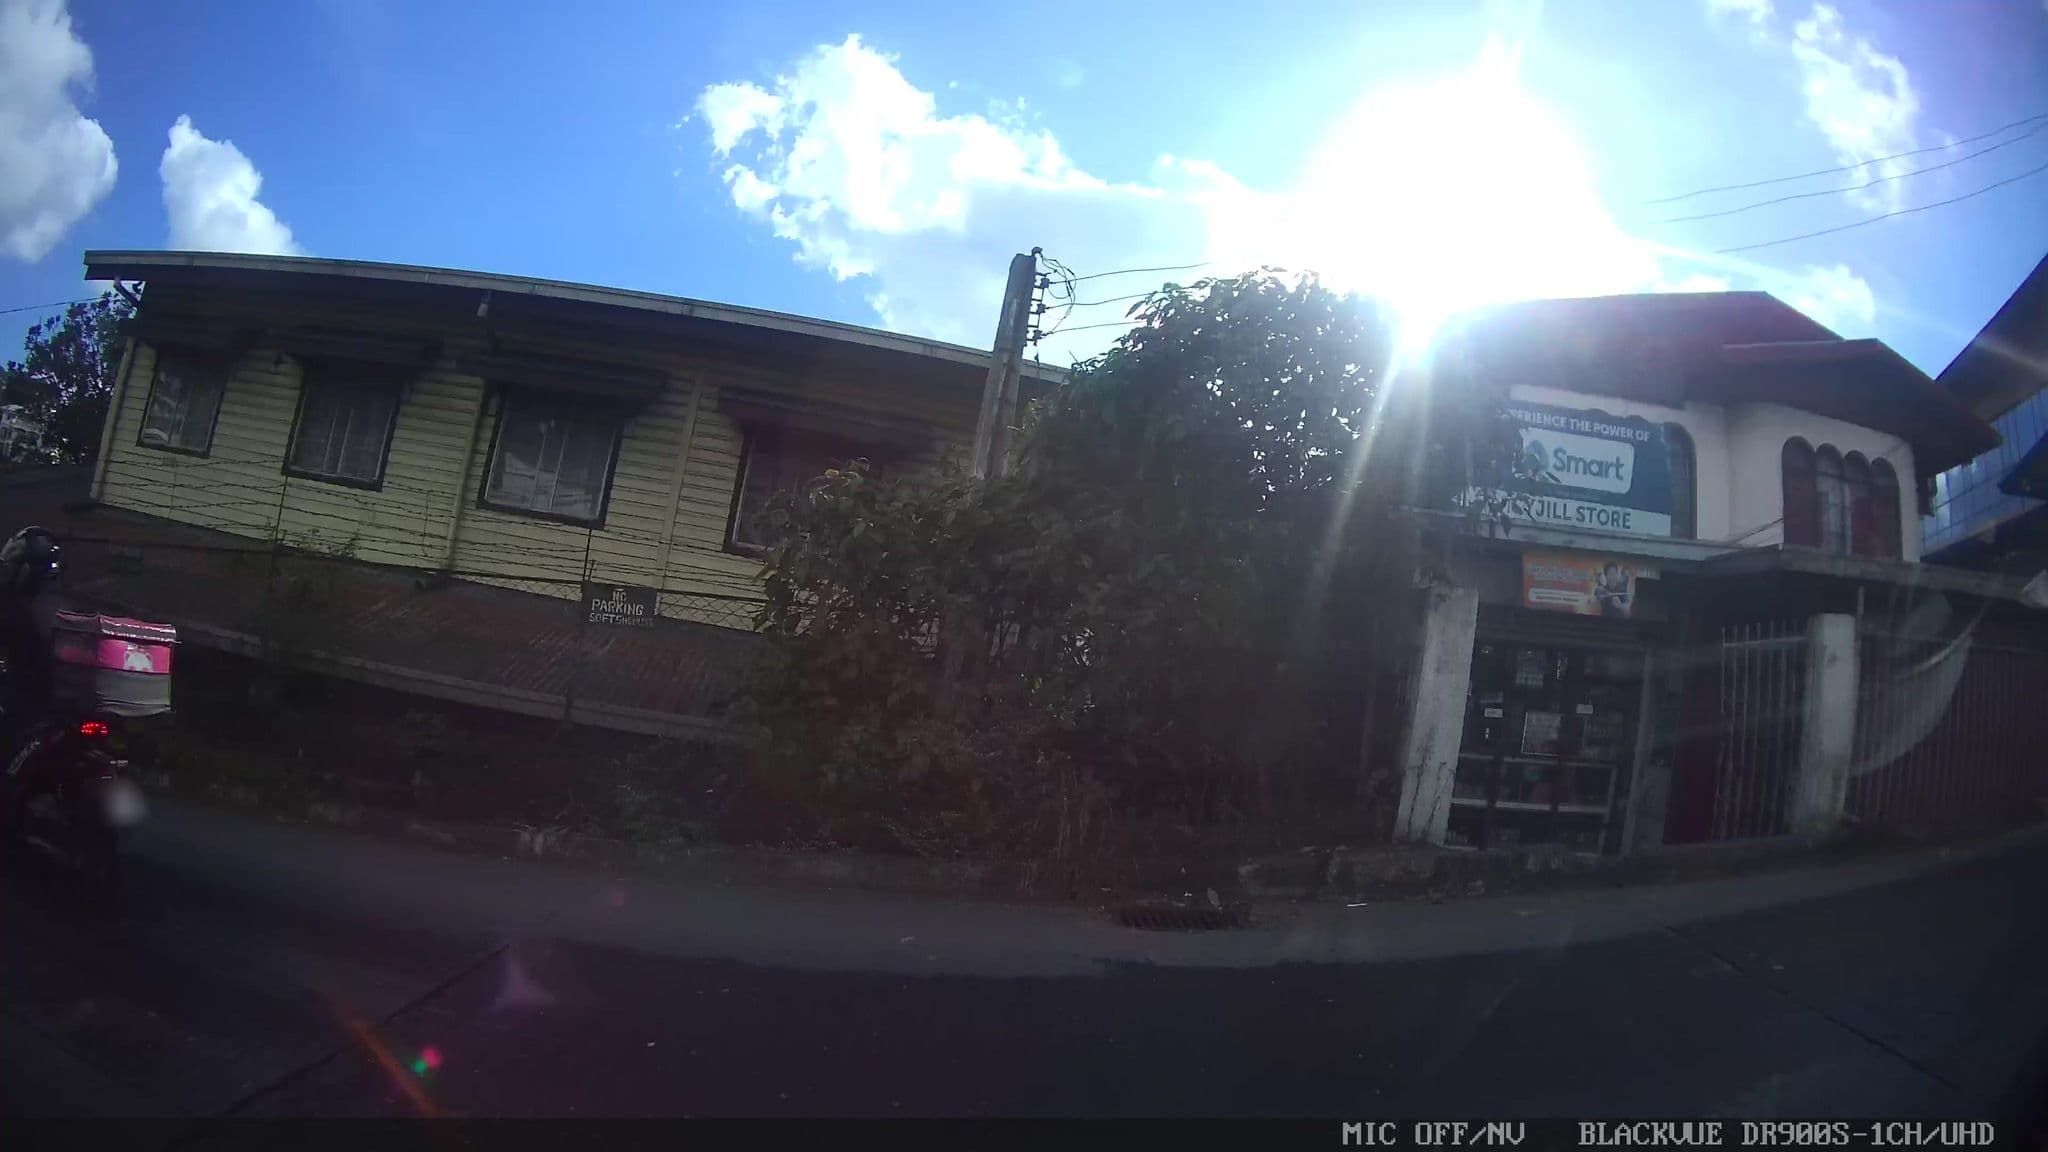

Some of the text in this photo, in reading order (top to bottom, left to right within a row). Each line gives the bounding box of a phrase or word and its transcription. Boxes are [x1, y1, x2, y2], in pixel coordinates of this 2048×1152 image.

[1569, 417, 1592, 432] THE
[1593, 423, 1634, 440] POWER
[1635, 430, 1651, 443] OF
[1553, 447, 1624, 481] Smart
[1575, 505, 1632, 530] STORE
[591, 598, 644, 616] PARKING
[612, 590, 627, 601] NO
